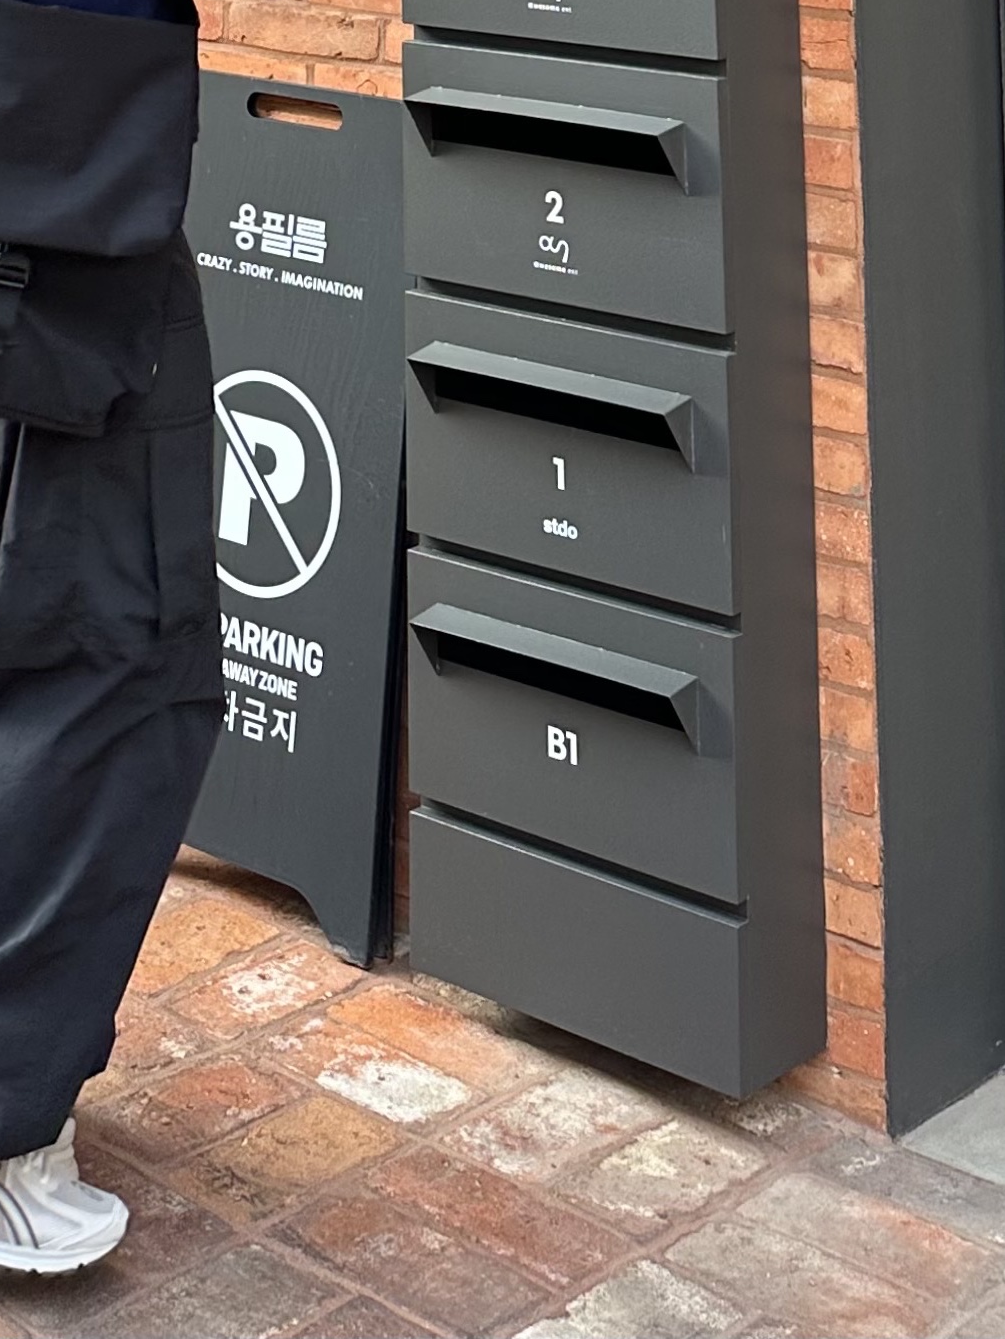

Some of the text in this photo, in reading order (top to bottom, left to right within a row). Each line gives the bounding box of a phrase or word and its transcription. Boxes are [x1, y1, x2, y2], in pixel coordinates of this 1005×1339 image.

[545, 190, 564, 224] 2
[229, 203, 327, 264] 용필름
[196, 252, 363, 301] CRAZY STORY IMAGINATION
[552, 457, 565, 491] 1
[543, 518, 578, 540] stdo
[258, 671, 298, 701] ZONE
[547, 725, 578, 766] B1
